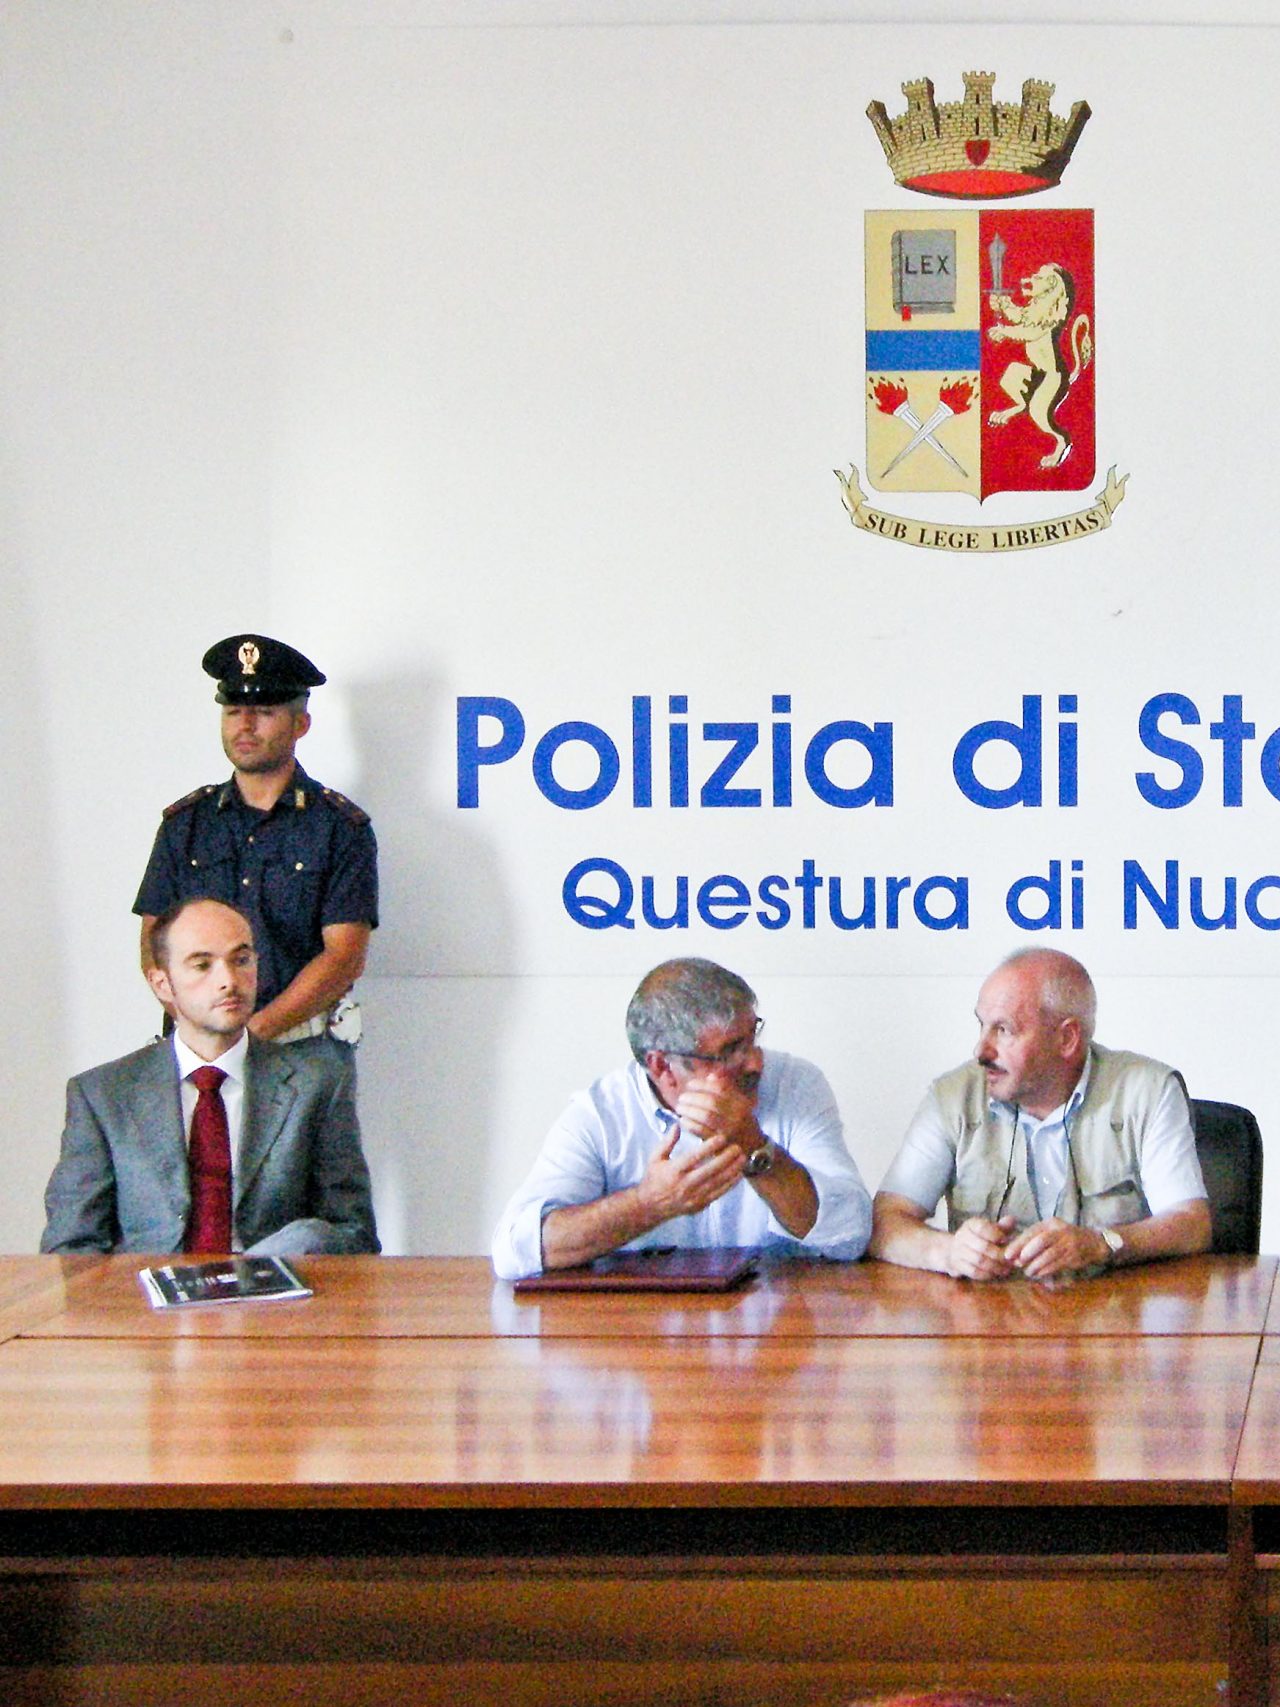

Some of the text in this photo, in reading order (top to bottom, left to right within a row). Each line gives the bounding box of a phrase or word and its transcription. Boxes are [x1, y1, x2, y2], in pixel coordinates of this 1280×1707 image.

[904, 254, 950, 275] LEX
[864, 511, 1100, 550] SUB LEGE LIBERTAS
[457, 695, 894, 810] Polizia
[953, 695, 1078, 809] di
[562, 858, 969, 930] Questura
[1006, 860, 1084, 930] di
